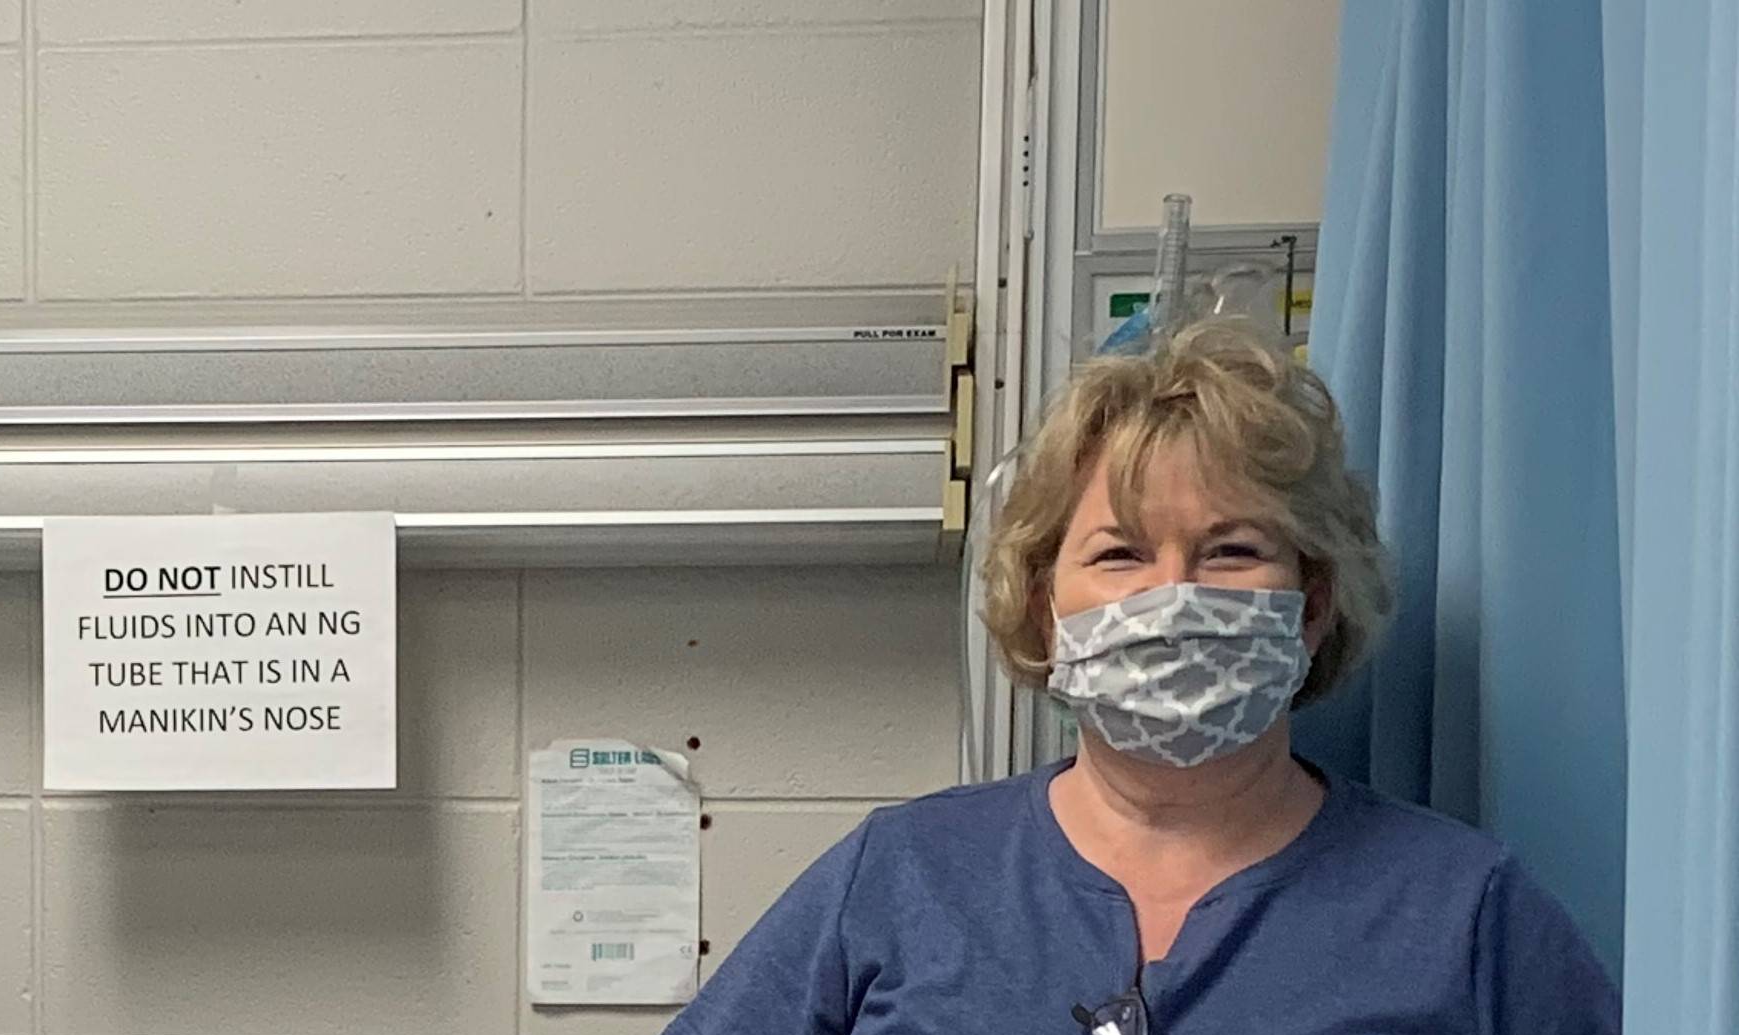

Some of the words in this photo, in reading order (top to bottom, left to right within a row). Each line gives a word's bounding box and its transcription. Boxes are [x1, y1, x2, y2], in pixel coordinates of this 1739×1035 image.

[104, 567, 148, 593] DO
[159, 565, 221, 592] NOT
[230, 563, 335, 590] INSTILL
[78, 614, 176, 640] FLUIDS
[186, 612, 256, 638] INTO
[265, 611, 307, 637] AN
[318, 610, 361, 636] NG
[88, 662, 164, 687] TUBE
[172, 660, 249, 686] THAT
[258, 659, 282, 684] IS
[292, 659, 320, 684] IN
[330, 658, 351, 683] A
[99, 706, 254, 734] MANIKIN'S
[264, 705, 342, 731] NOSE
